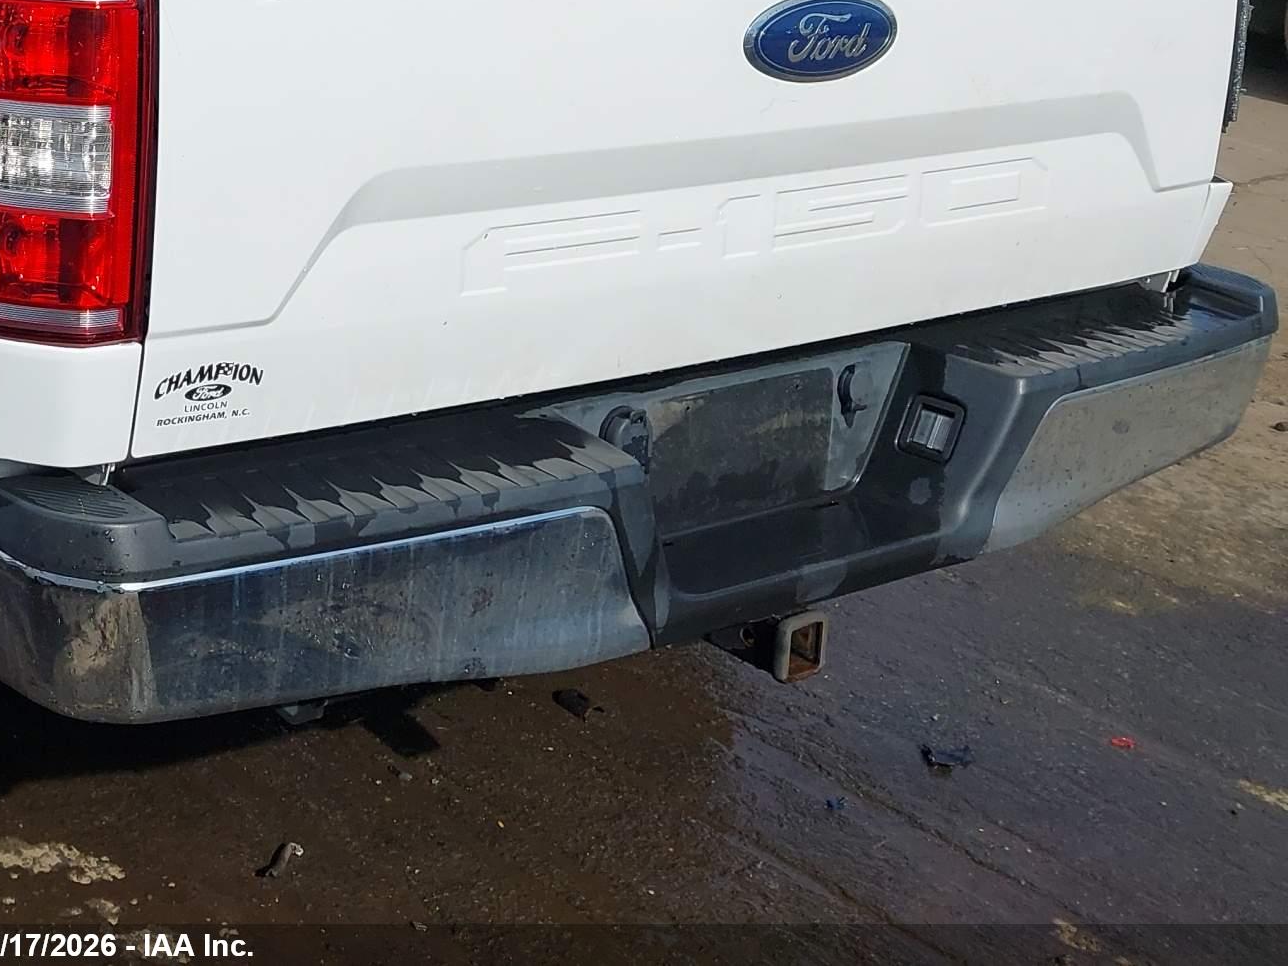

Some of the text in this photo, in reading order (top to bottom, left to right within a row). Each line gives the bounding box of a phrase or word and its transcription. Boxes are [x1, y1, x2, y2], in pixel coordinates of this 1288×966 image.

[787, 12, 871, 63] Ford
[461, 157, 1049, 297] F-150
[154, 362, 264, 399] CHAMPION
[192, 386, 225, 400] Ford
[156, 408, 251, 427] ROCKINGHAM, N.C.
[184, 401, 228, 413] LINCOLN
